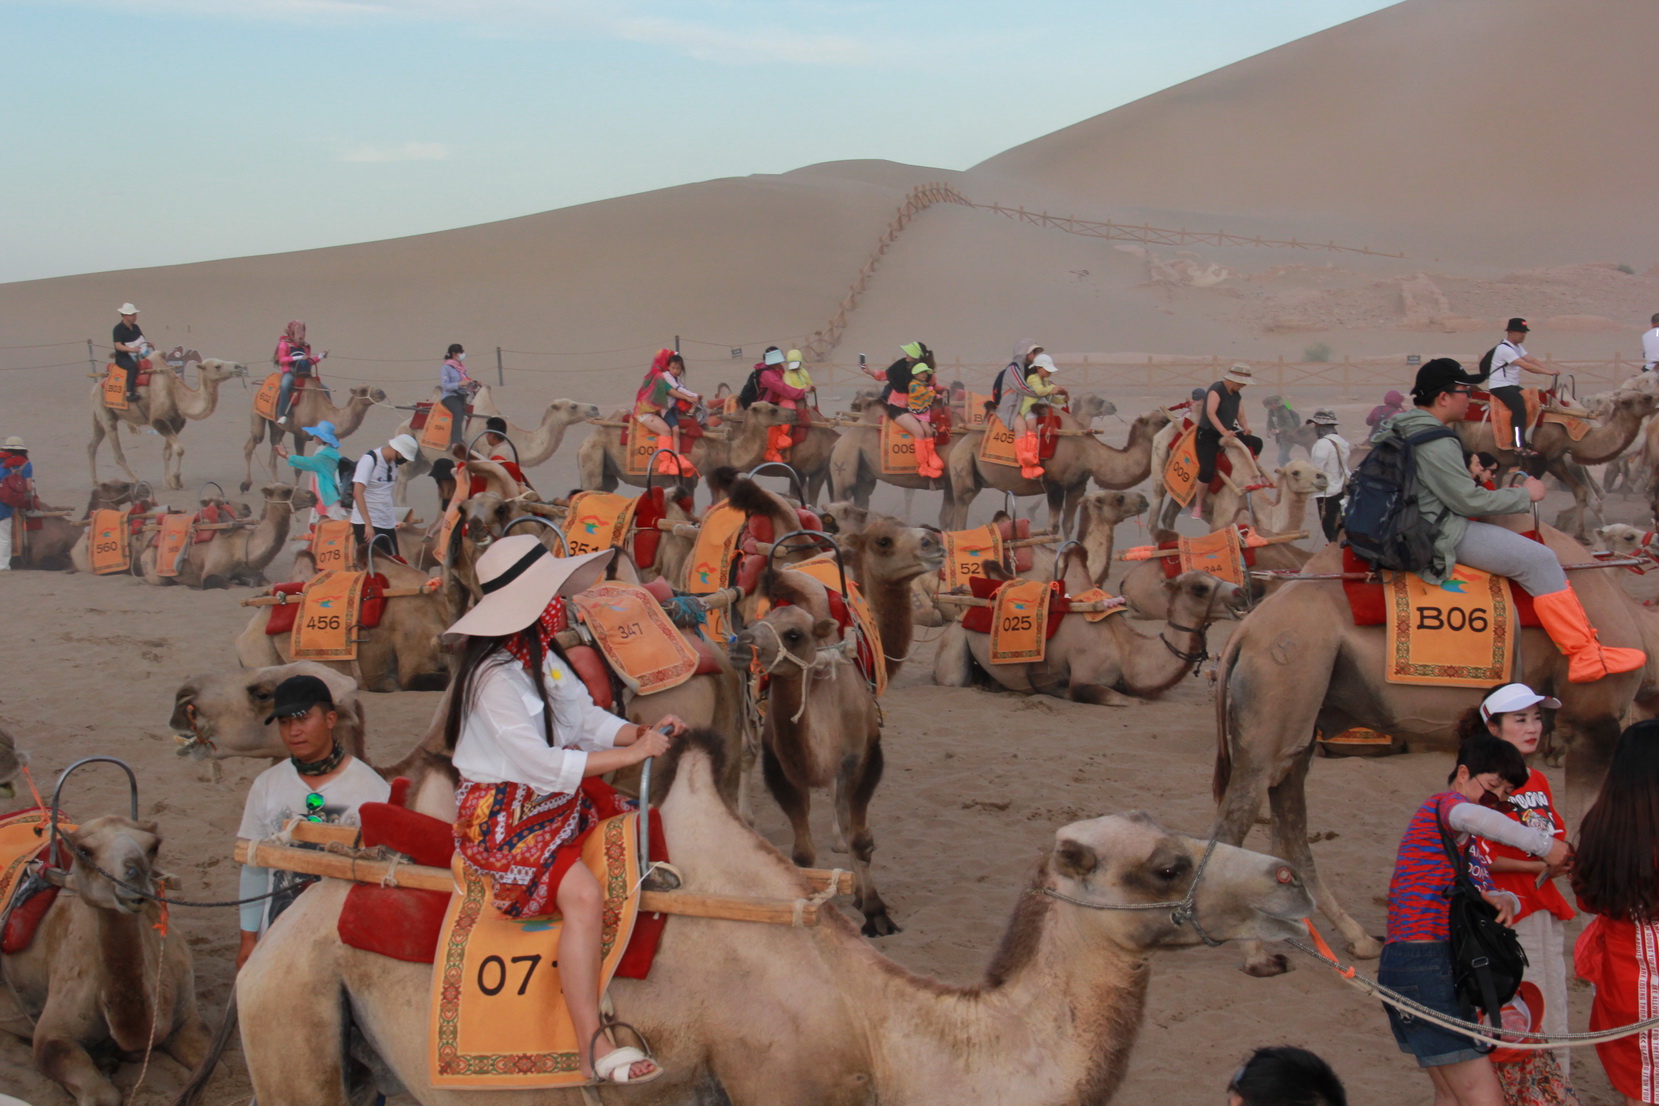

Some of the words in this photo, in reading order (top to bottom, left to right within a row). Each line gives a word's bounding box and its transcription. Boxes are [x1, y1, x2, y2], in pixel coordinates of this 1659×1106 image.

[993, 432, 1016, 444] 405
[1173, 461, 1190, 483] 009
[96, 541, 119, 554] 560
[319, 549, 341, 563] 078
[960, 562, 981, 575] 52
[306, 615, 341, 630] 456
[1002, 615, 1032, 632] 025
[1416, 606, 1488, 633] B06
[617, 622, 643, 639] 347
[477, 953, 563, 997] 07
